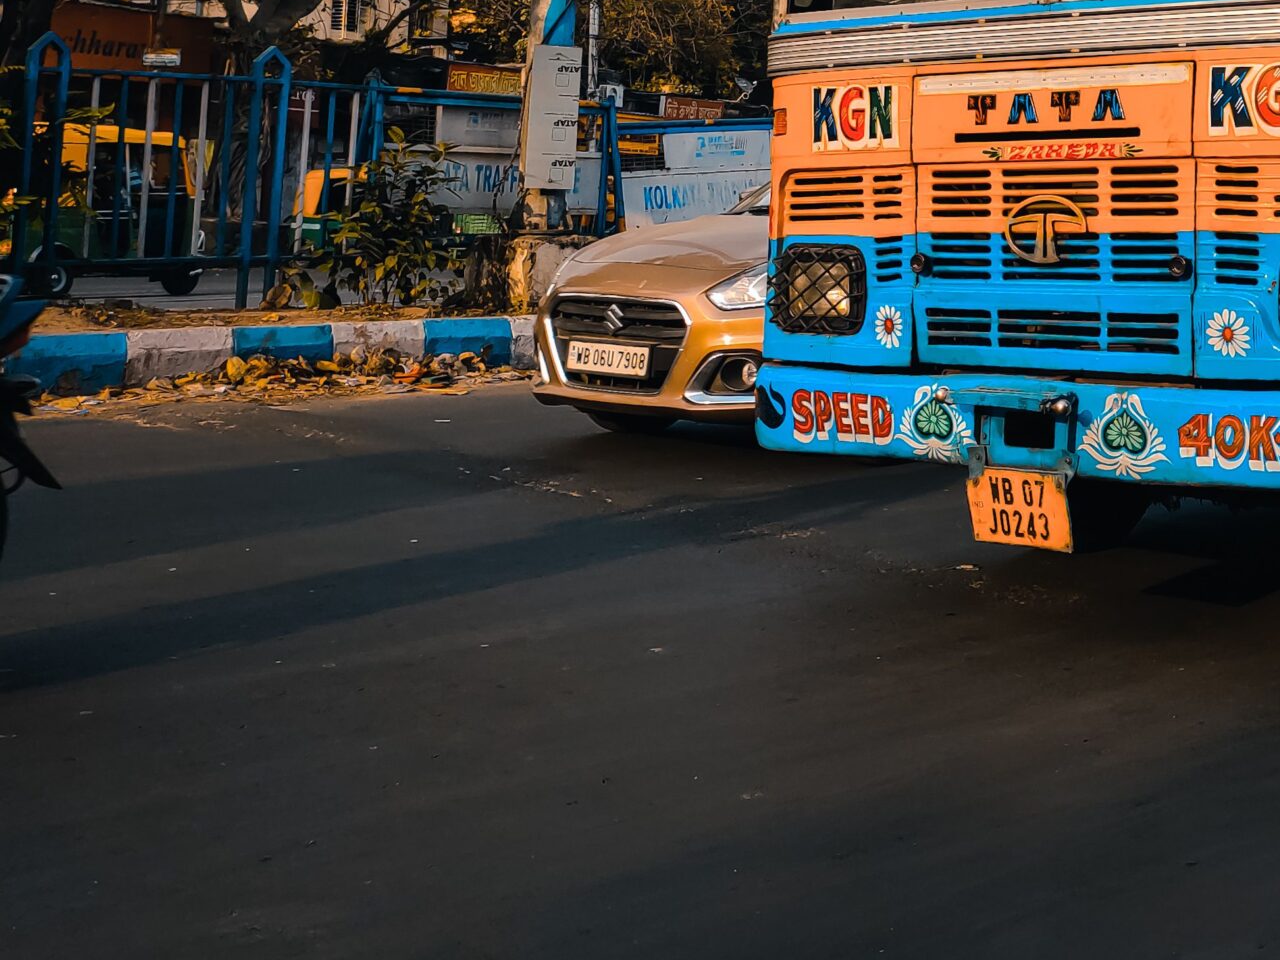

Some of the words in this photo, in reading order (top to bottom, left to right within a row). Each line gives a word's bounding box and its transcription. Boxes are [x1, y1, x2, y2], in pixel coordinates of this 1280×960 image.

[812, 85, 897, 148] KGN
[967, 89, 1126, 125] TATA
[576, 346, 591, 364] WB
[616, 351, 646, 370] 7908
[791, 388, 894, 443] SPEED
[988, 475, 1014, 505] WB
[1021, 479, 1045, 508] 07
[989, 507, 1050, 541] J0243
